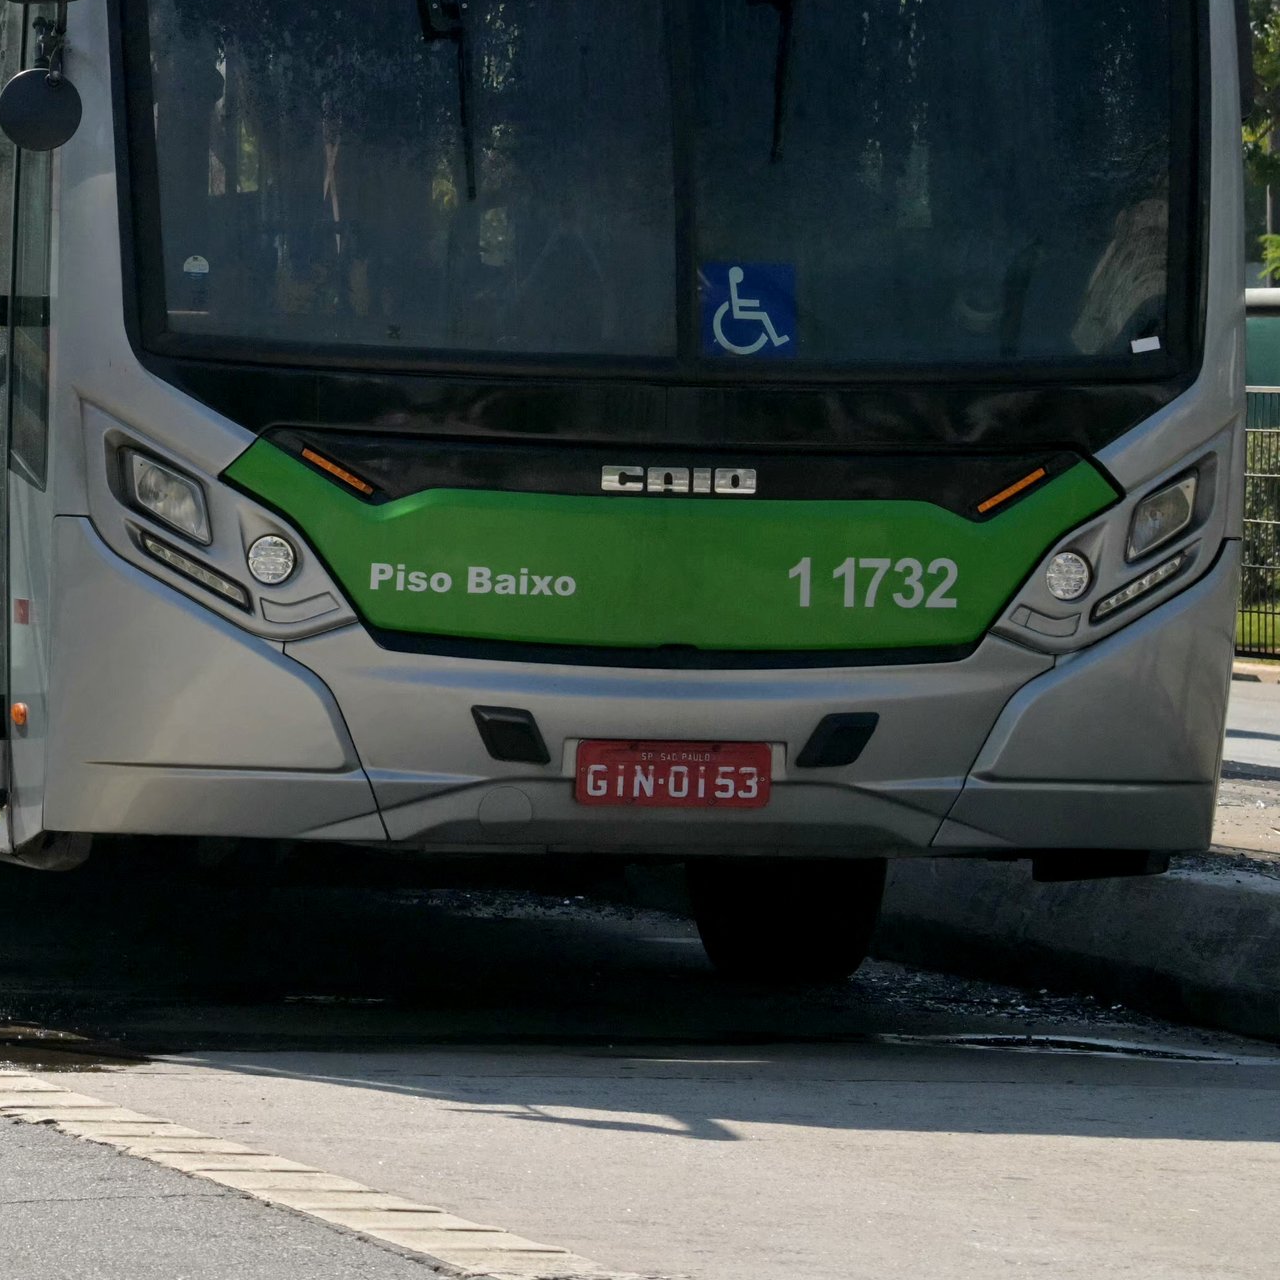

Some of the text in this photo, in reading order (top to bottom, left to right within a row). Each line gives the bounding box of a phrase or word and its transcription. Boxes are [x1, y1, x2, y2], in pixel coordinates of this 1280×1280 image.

[601, 465, 757, 494] CAIO
[369, 563, 577, 597] Piso Baixo
[641, 752, 653, 761] SP
[681, 753, 710, 762] PAULO
